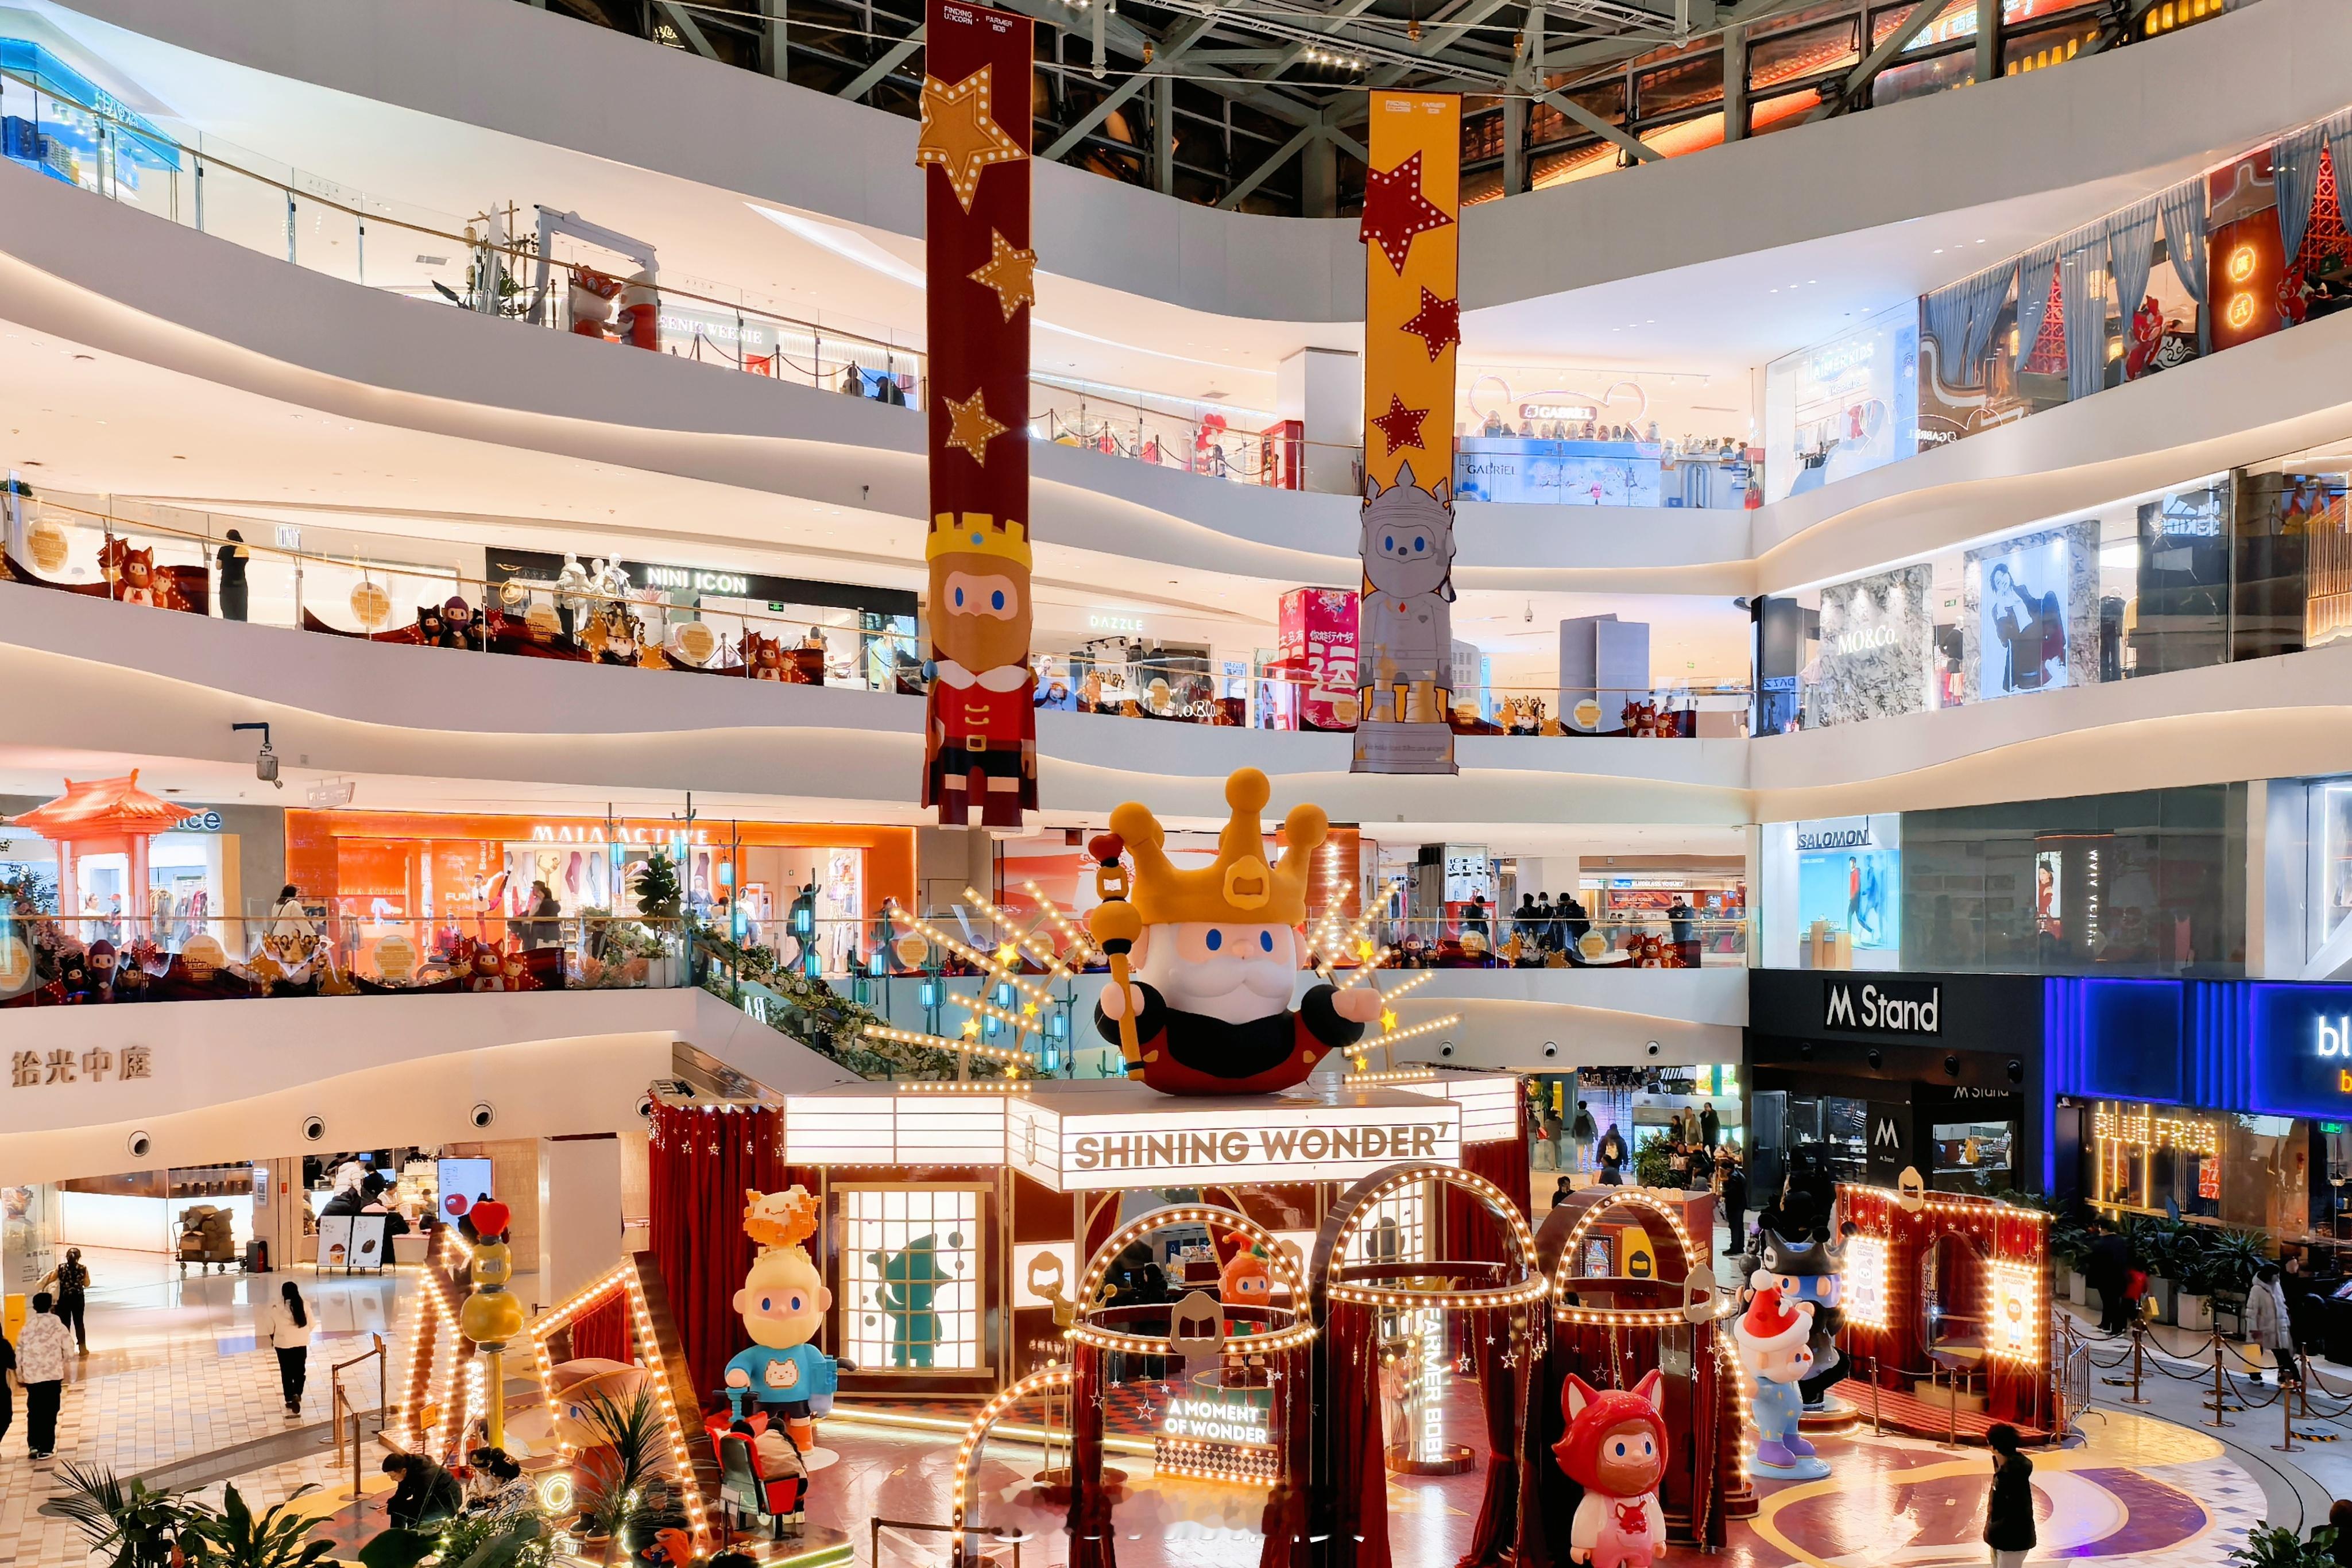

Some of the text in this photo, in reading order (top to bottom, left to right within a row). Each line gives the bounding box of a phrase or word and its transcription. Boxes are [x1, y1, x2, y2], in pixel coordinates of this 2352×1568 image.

[944, 6, 972, 18] FINDING
[986, 16, 1013, 27] FARMER
[660, 316, 762, 344] EENIE WEENIE
[647, 567, 746, 593] NINI ICON
[1090, 615, 1143, 630] DAZZLE
[1837, 625, 1898, 656] MO&Co.
[532, 826, 709, 844] MAIA ACTIVE
[1798, 829, 1867, 848] SALOMON
[446, 892, 470, 901] FUN
[1826, 984, 1938, 1032] M Stand
[11, 1046, 152, 1087] 拾光中庭
[2095, 1112, 2215, 1153] BLUE FROG
[1076, 1132, 1249, 1169] SHINING
[1423, 1307, 1441, 1402] FARMER
[1169, 1399, 1259, 1423] A MOMENT
[1165, 1418, 1267, 1443] OF WONDER
